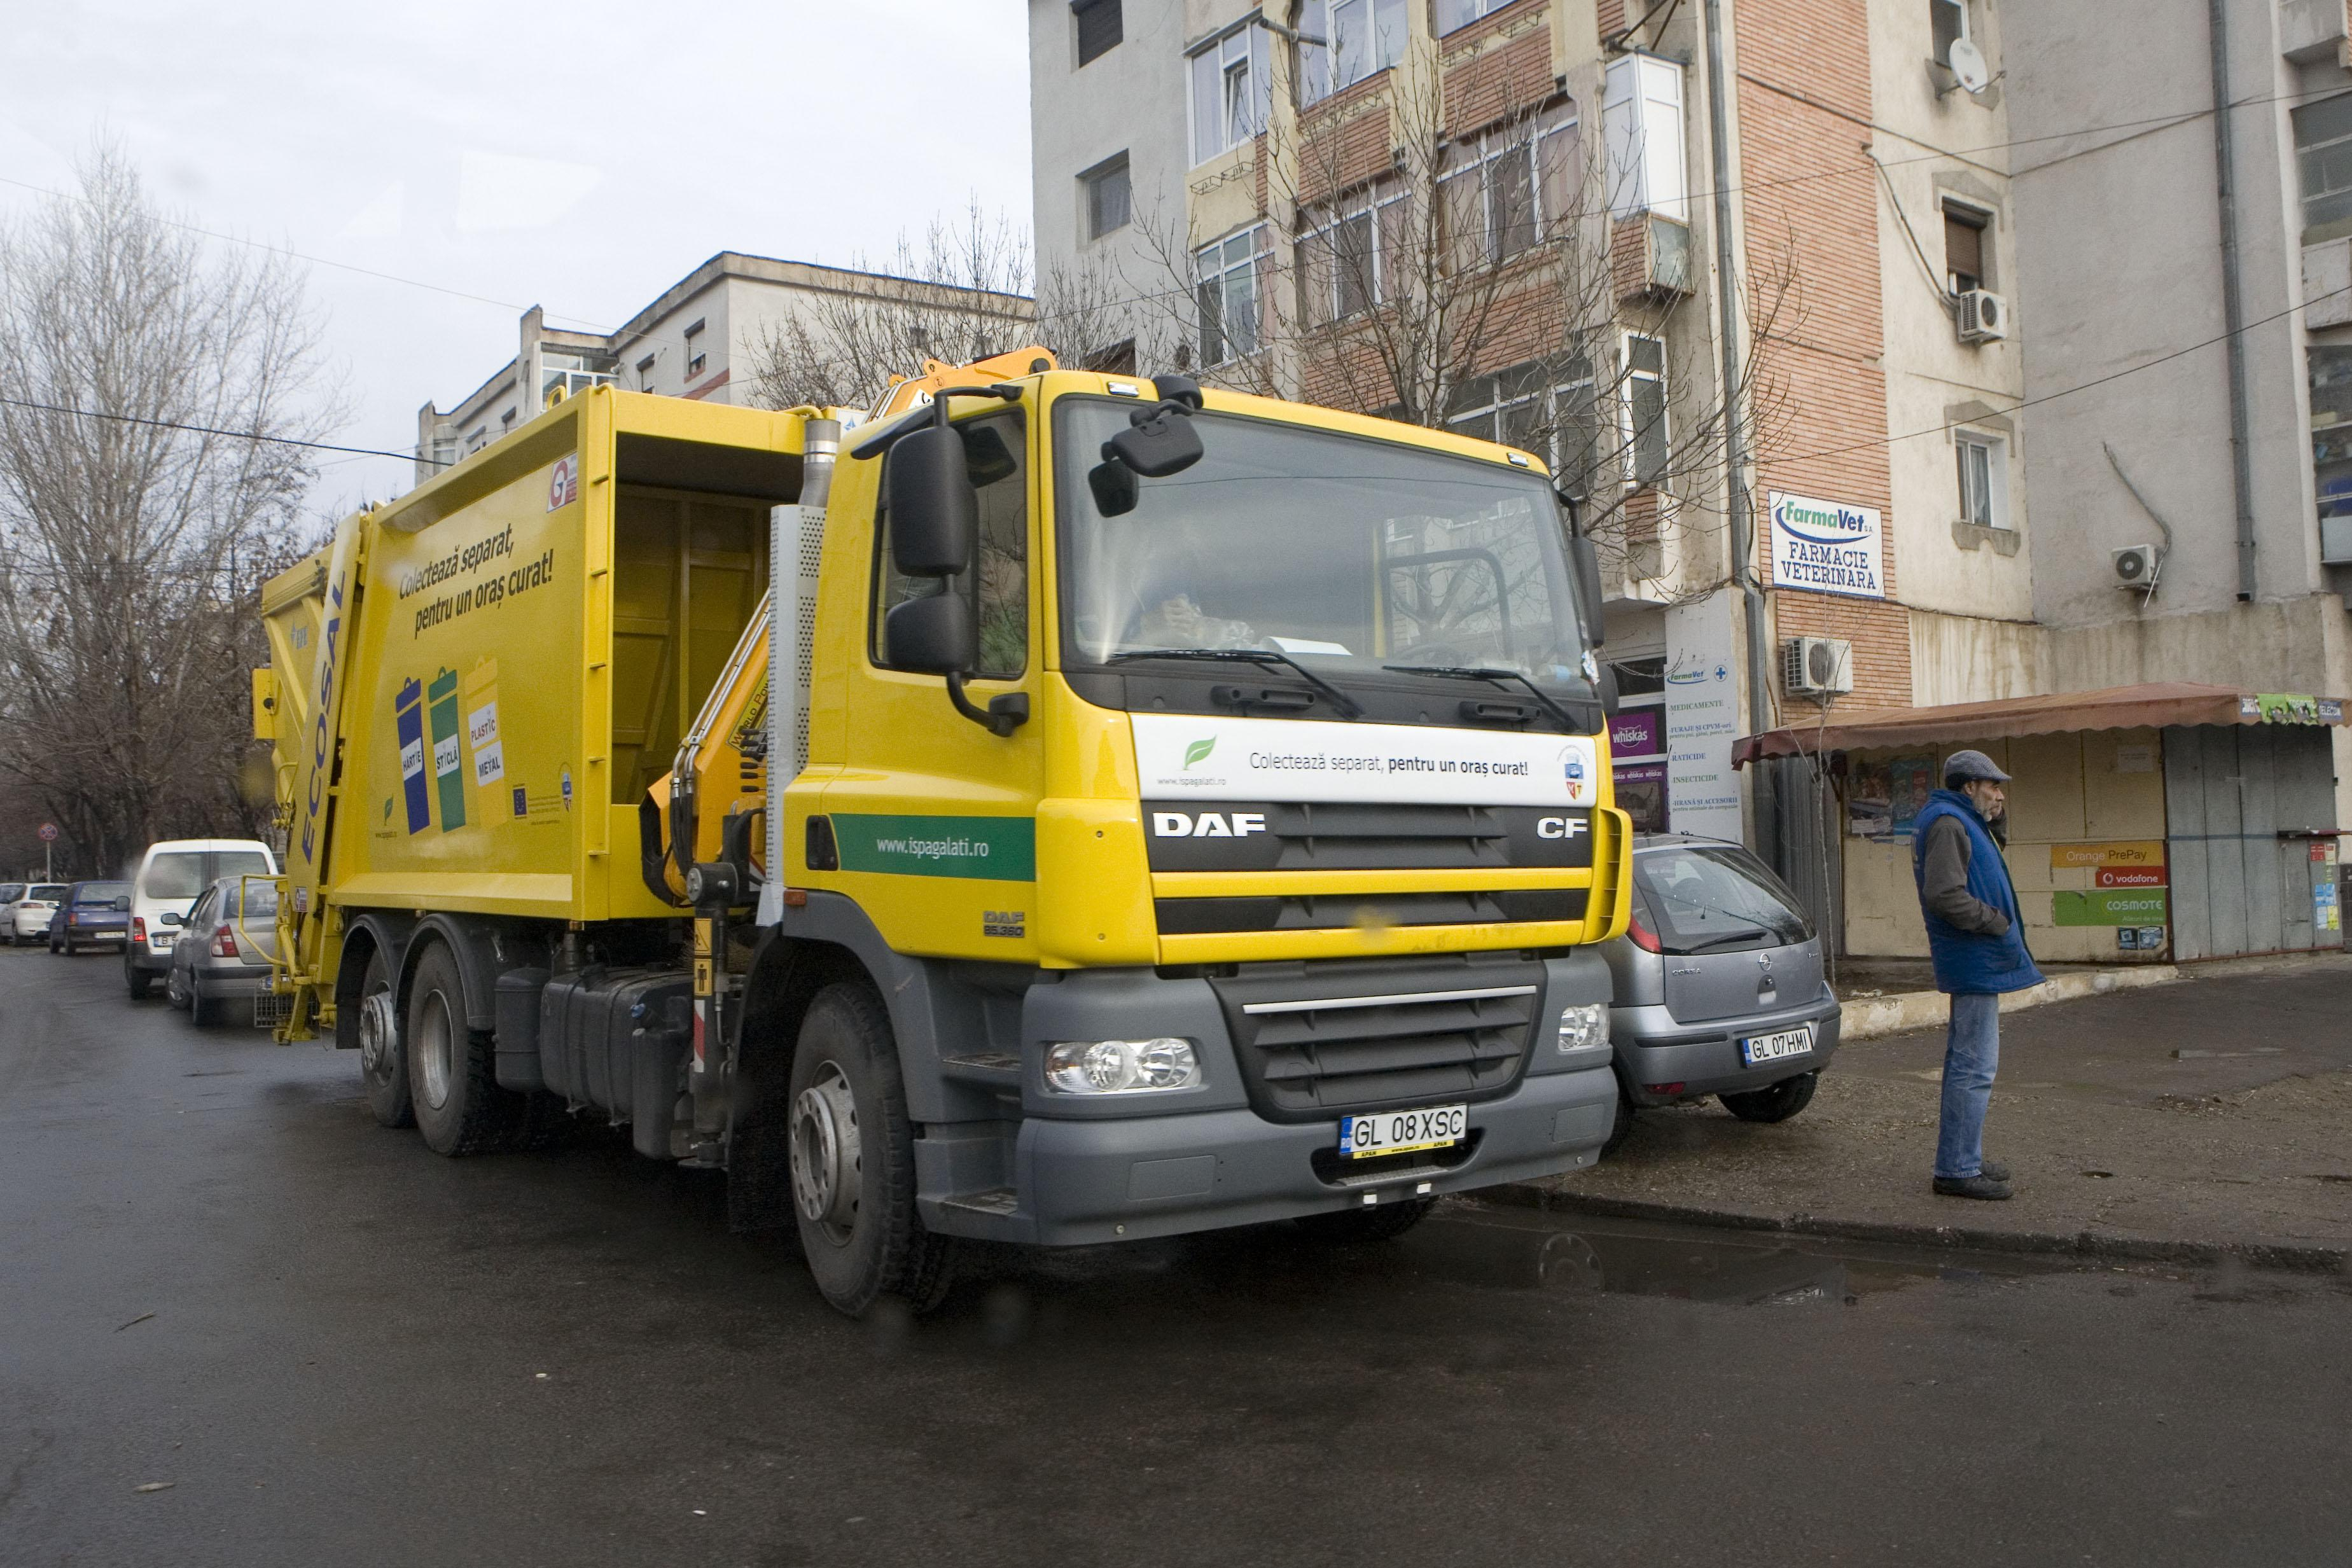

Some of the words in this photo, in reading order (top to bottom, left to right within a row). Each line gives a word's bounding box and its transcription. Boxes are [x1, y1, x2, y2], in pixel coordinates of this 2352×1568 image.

[1785, 501, 1864, 532] FarmaVet
[399, 544, 460, 600] Colectează
[460, 522, 514, 574] separat,
[1788, 541, 1868, 569] FARMACIE
[1781, 560, 1877, 590] VETERINARA
[414, 597, 453, 640] pentru
[456, 588, 472, 617] un
[475, 575, 505, 609] oraș
[508, 548, 554, 597] curat!
[1670, 670, 1704, 681] FarmaVet
[302, 569, 346, 866] ECOSAL
[732, 707, 758, 746] WRLD
[471, 718, 496, 743] PLASTIC
[1612, 730, 1648, 744] whiskas
[478, 756, 501, 778] METAL
[1249, 751, 1326, 770] Colectează
[1331, 755, 1384, 774] separat,
[1388, 756, 1435, 774] pentru
[1439, 759, 1456, 773] un
[1460, 761, 1488, 777] oraș
[1492, 761, 1529, 776] curat!
[1672, 753, 1706, 762] RATICIDE
[1157, 777, 1227, 787] www.ispagalati.ro
[1673, 774, 1719, 784] INSECTICIDE
[1152, 812, 1267, 838] DAF
[1536, 817, 1588, 839] CF
[876, 836, 990, 860] www.ispagalati.ro
[2066, 850, 2105, 863] Orange
[2108, 849, 2147, 861] PrePay
[2116, 874, 2159, 883] vodafone
[2106, 899, 2163, 911] COSMOTE
[984, 911, 1024, 924] DAF
[1671, 968, 1702, 976] CORSA
[1753, 1039, 1770, 1058] GL
[1354, 1119, 1382, 1147] GL
